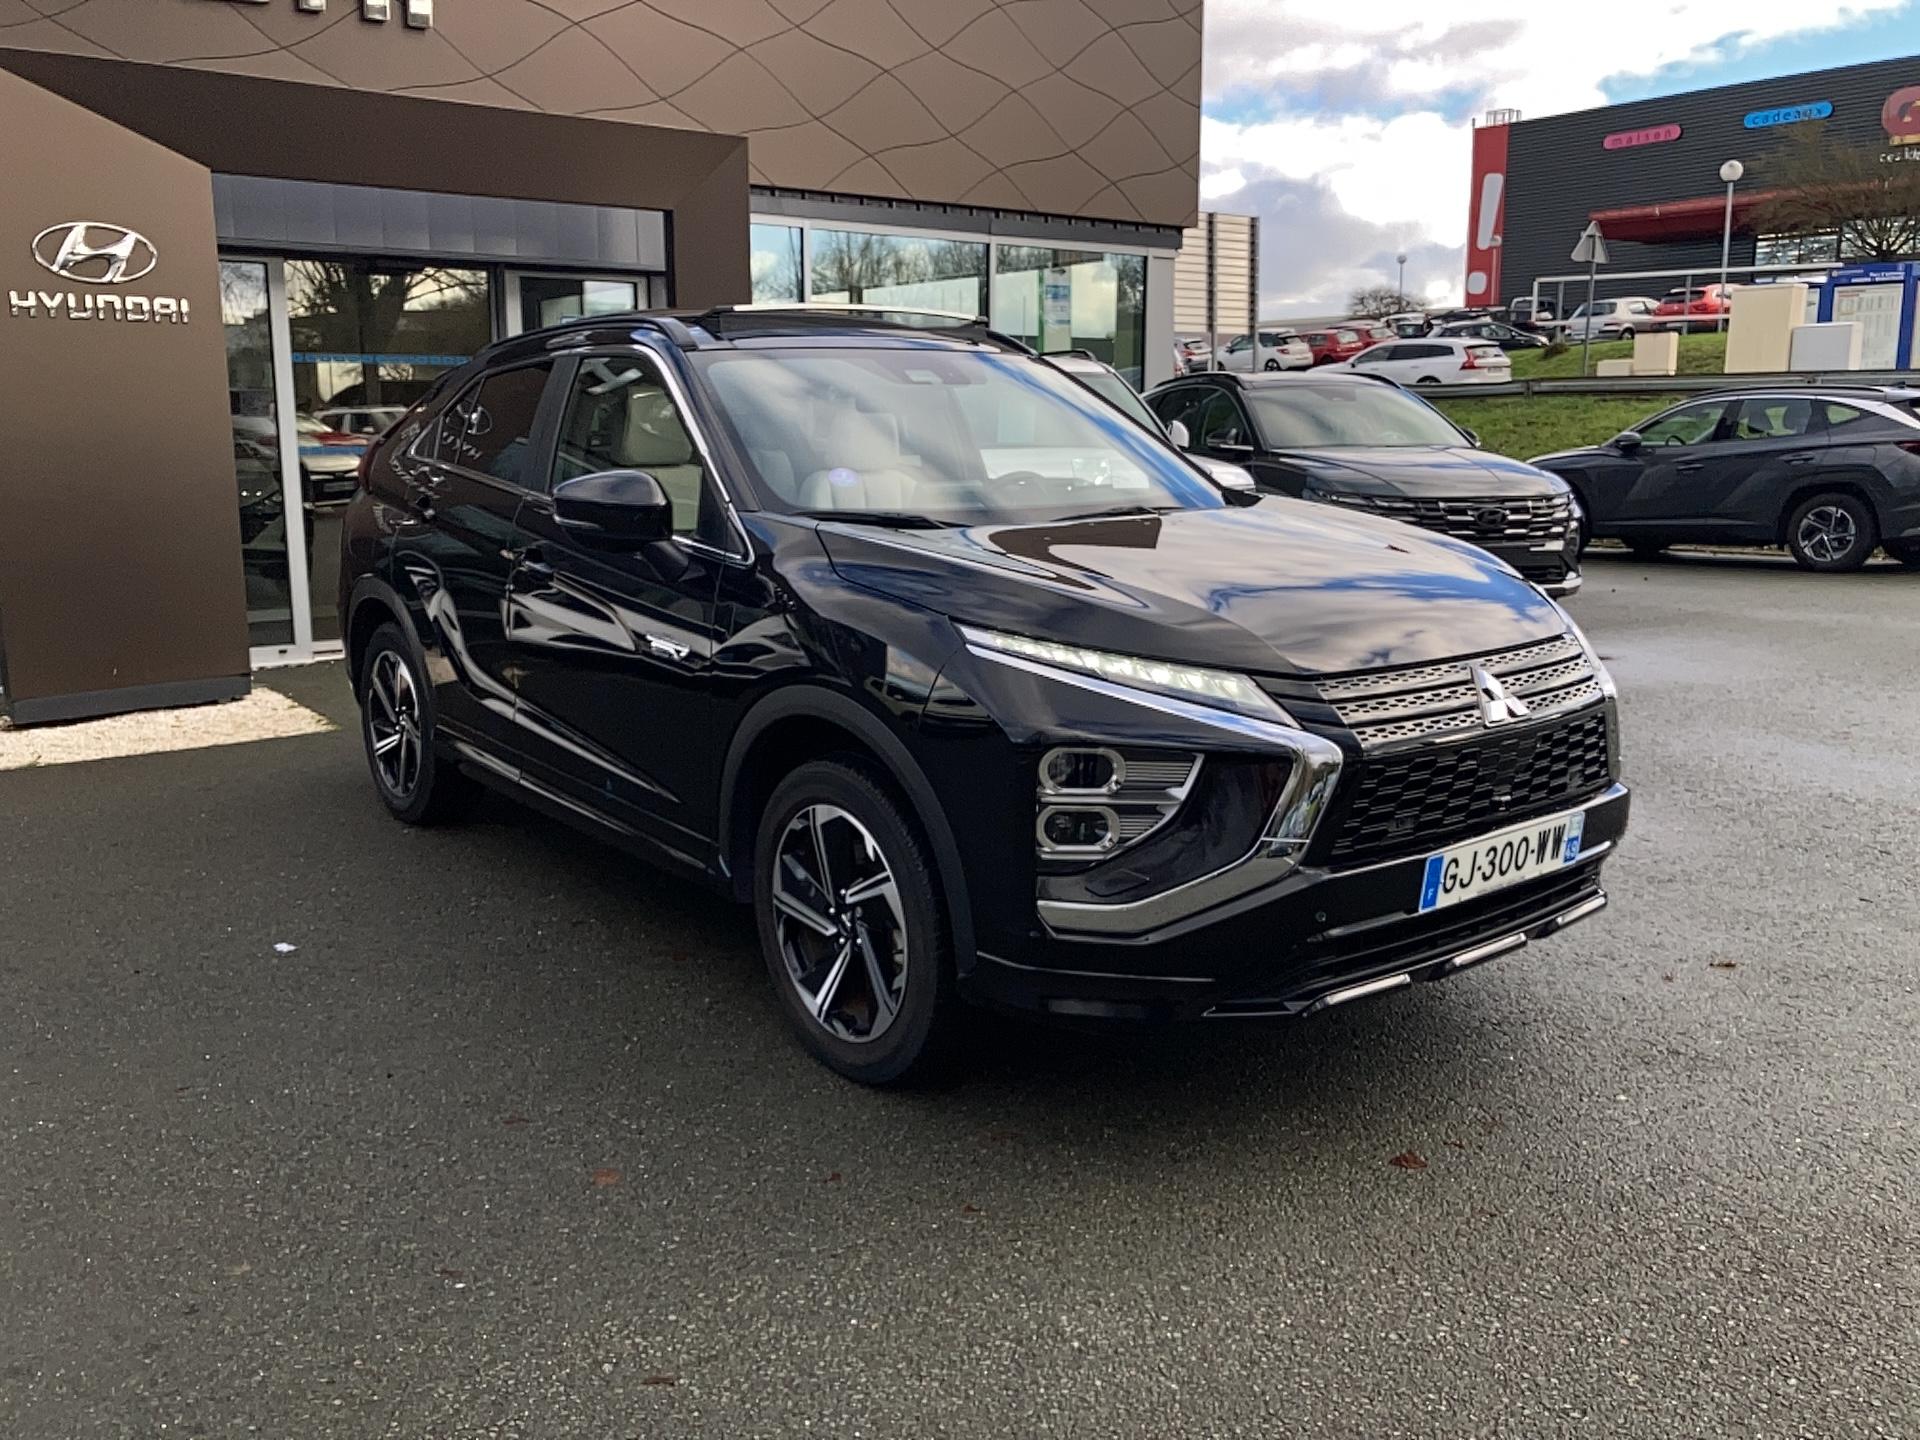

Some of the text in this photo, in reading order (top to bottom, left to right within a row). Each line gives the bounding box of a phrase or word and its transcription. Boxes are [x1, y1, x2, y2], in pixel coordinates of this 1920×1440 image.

[1612, 129, 1671, 145] maison
[9, 290, 189, 323] HYUNDAI
[1427, 888, 1434, 900] F
[1442, 823, 1567, 894] GJ-300-WW
